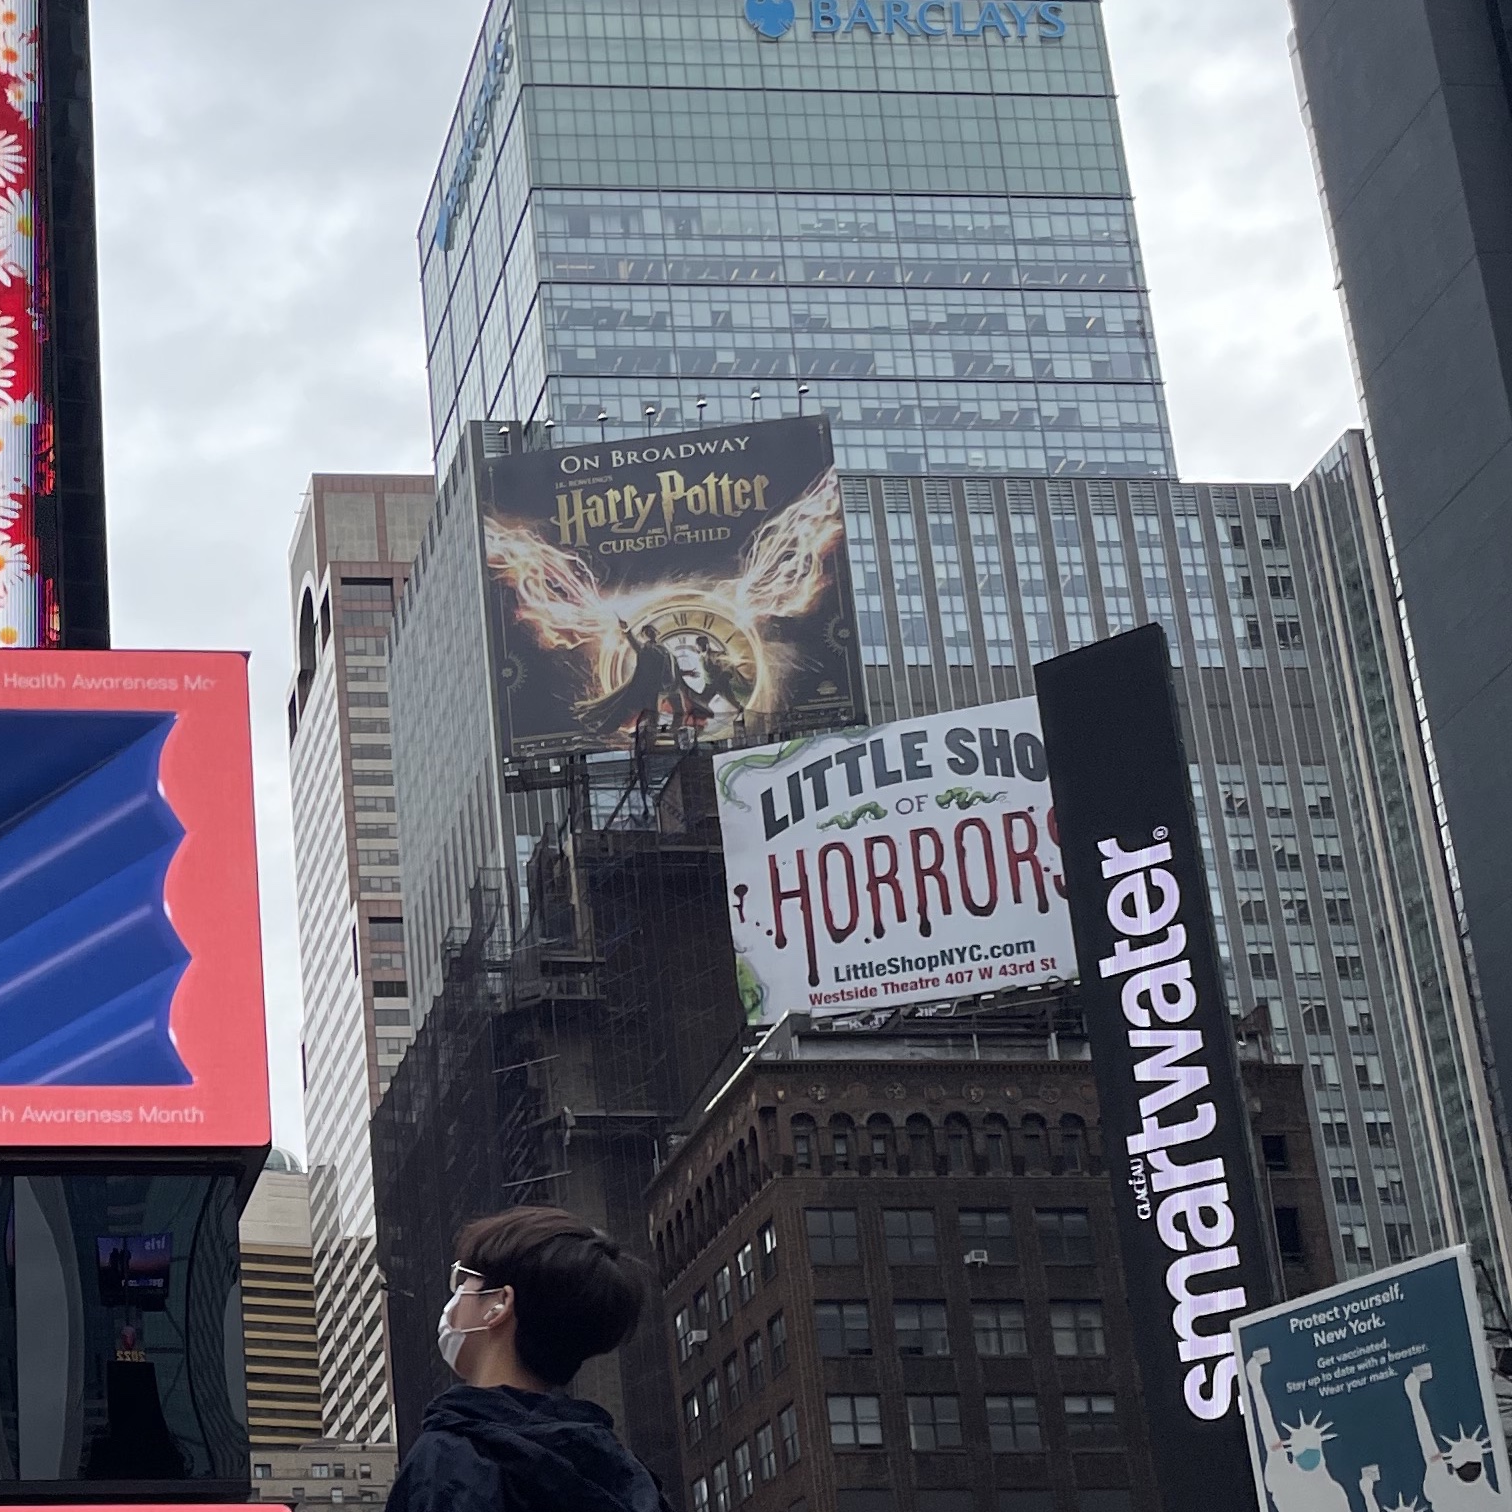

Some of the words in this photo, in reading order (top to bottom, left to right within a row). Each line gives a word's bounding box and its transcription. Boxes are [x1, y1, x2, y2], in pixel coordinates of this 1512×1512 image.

[813, 0, 1067, 39] BARCLAYS
[550, 483, 657, 547] Harry
[656, 470, 770, 540] Potter
[599, 534, 669, 555] CURSED
[673, 527, 731, 545] CHILD
[3, 672, 66, 690] Health
[73, 674, 178, 691] Awareness
[760, 730, 934, 842] LITTLE
[944, 727, 1048, 782] SHO
[895, 793, 928, 816] OF
[808, 983, 878, 1007] Westside
[882, 974, 940, 996] Theatre
[944, 967, 975, 987] 407
[979, 967, 994, 980] W
[998, 960, 1035, 979] 43rd
[1040, 955, 1057, 972] St
[833, 939, 1036, 984] LittleShopNYC.com
[20, 1106, 133, 1124] Awareness
[139, 1105, 205, 1124] Month
[1096, 836, 1250, 1421] smartwater
[1289, 1304, 1342, 1334] Protect
[1342, 1282, 1405, 1321] yourself,
[1313, 1325, 1347, 1348] New
[1348, 1312, 1386, 1336] York.
[1286, 1380, 1306, 1394] Stay
[1308, 1376, 1321, 1388] up
[1321, 1371, 1333, 1382] to
[1334, 1364, 1356, 1379] date
[1357, 1356, 1378, 1372] with
[1388, 1343, 1430, 1362] booster.
[1317, 1355, 1335, 1369] Get
[1336, 1337, 1391, 1362] vaccinated.
[1318, 1384, 1345, 1398] Wear
[1346, 1376, 1367, 1393] your
[1369, 1366, 1399, 1382] mask.
